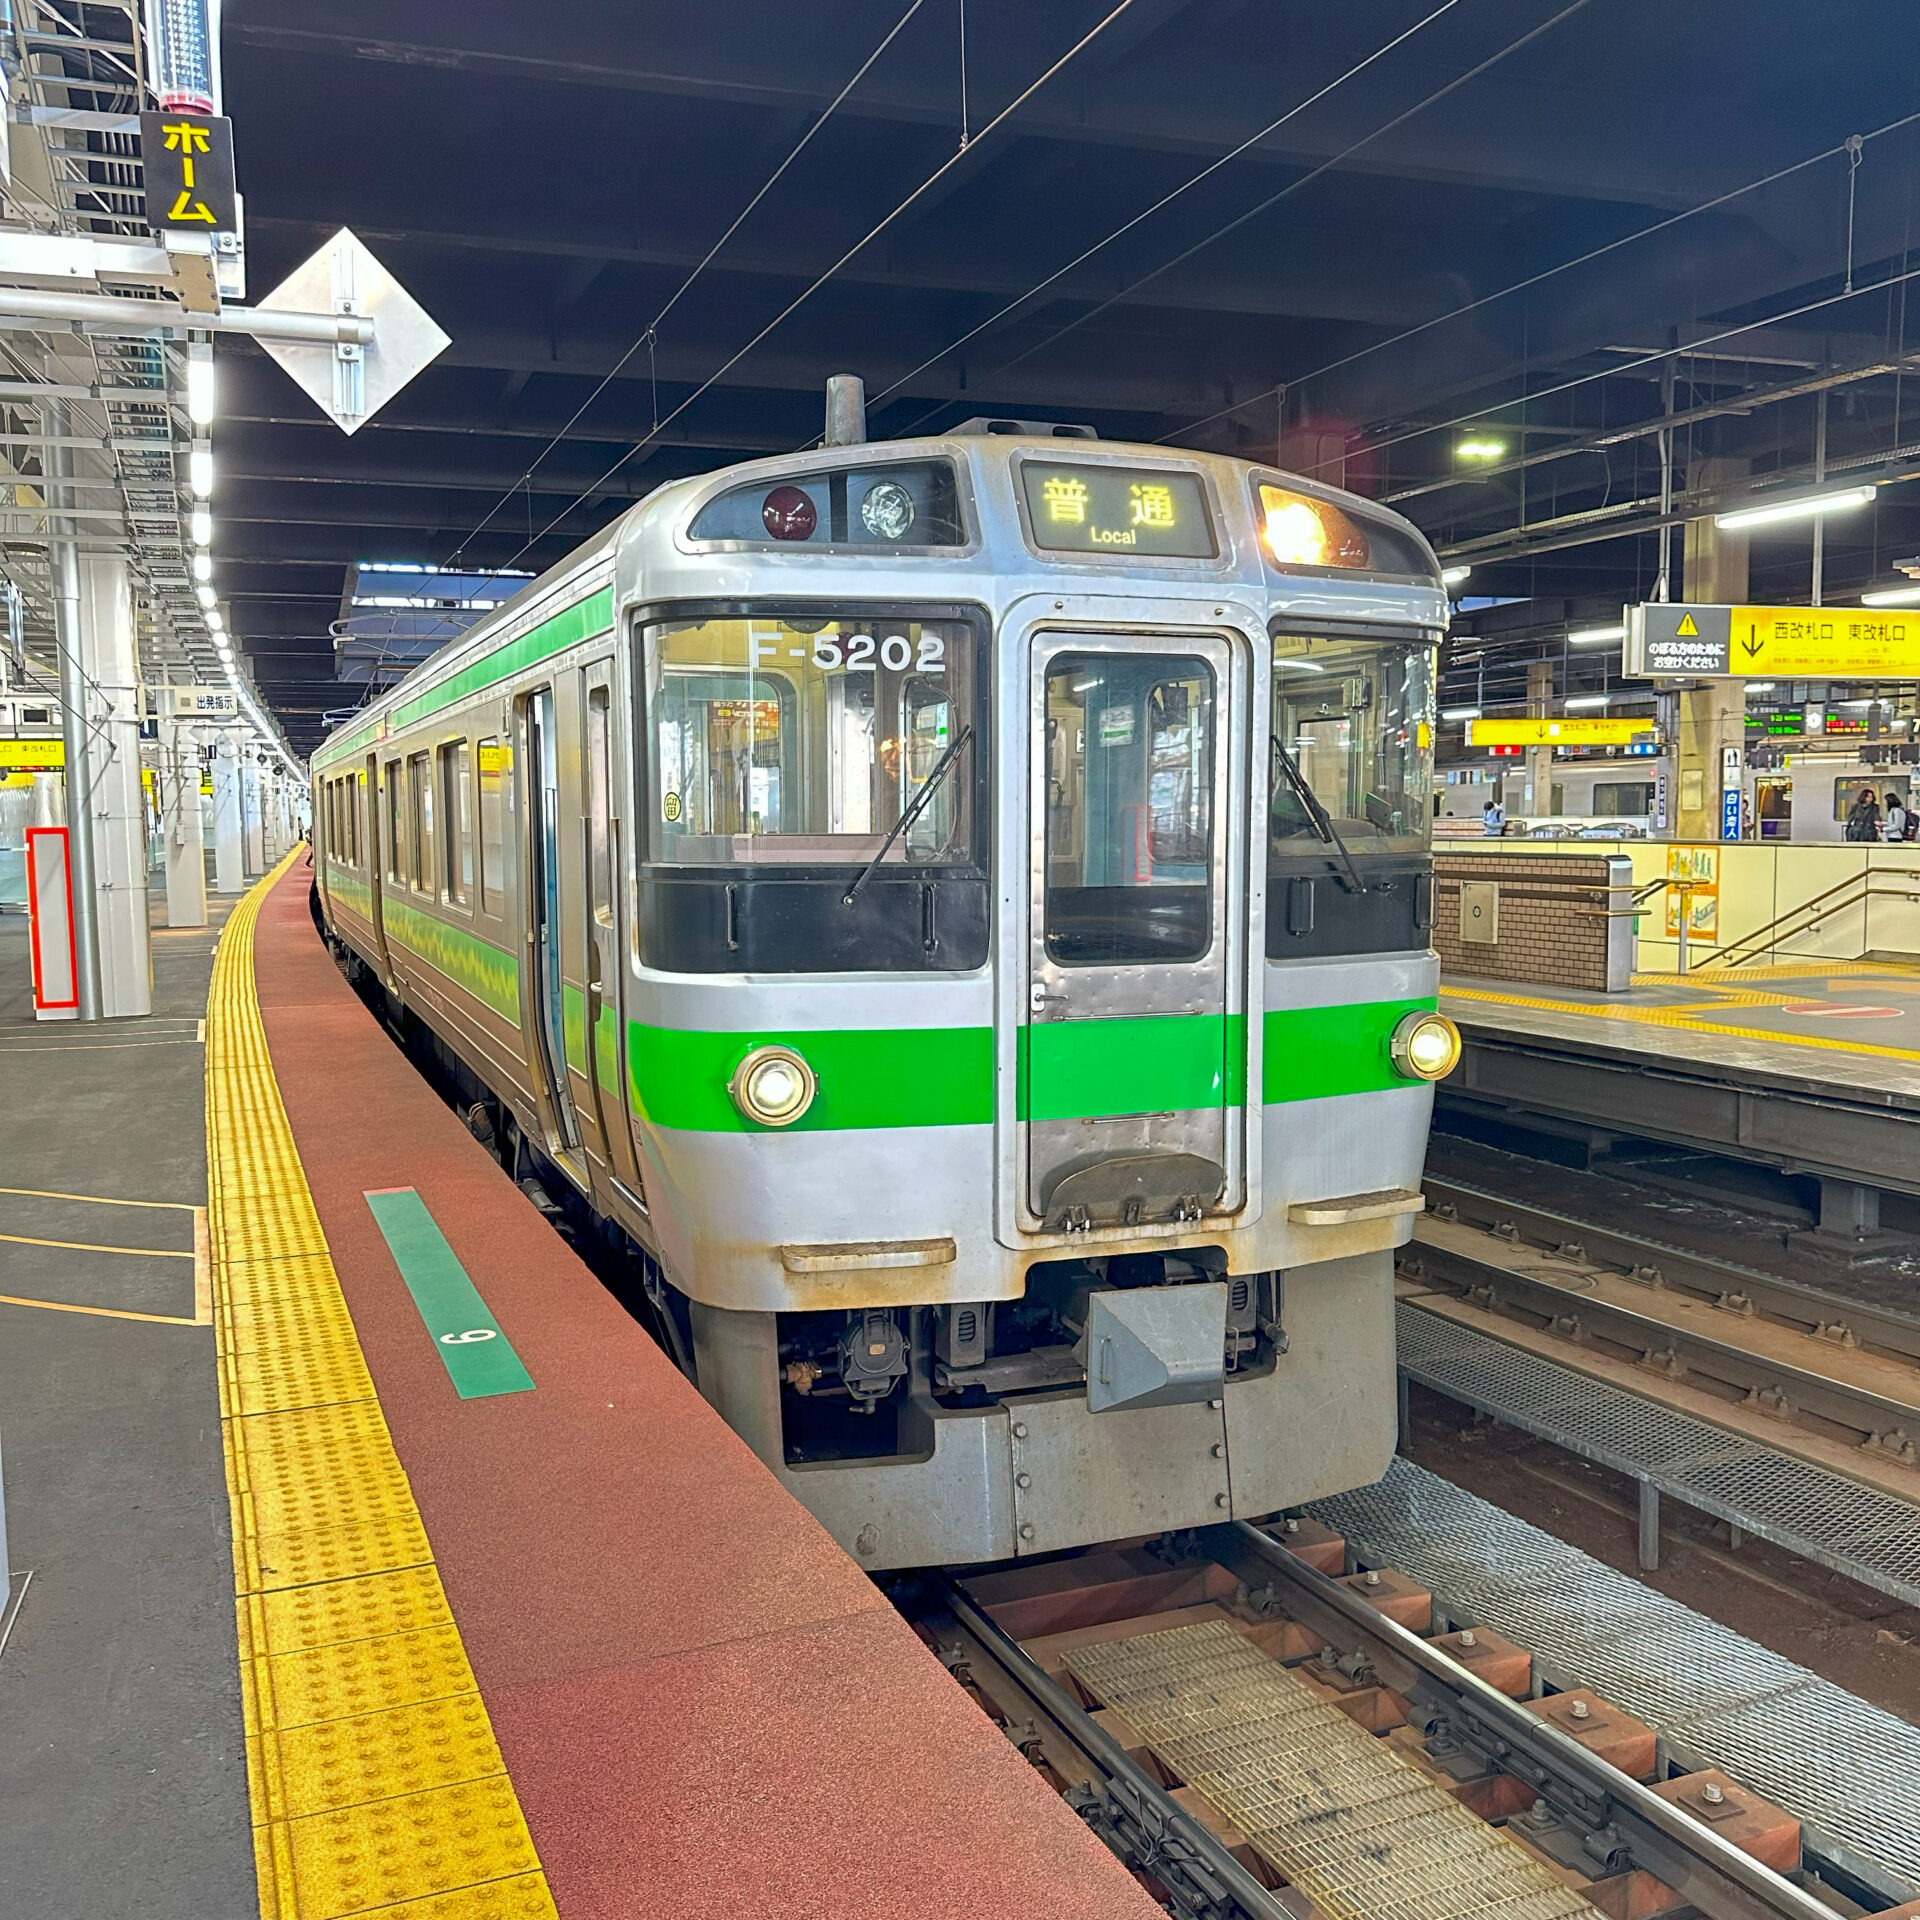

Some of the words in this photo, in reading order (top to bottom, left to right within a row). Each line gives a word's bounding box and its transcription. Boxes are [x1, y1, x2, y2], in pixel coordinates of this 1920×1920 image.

[162, 122, 217, 224] ホーム
[1043, 477, 1175, 527] 普通
[1090, 526, 1137, 545] Local
[1774, 621, 1834, 640] 西改札口
[1848, 623, 1906, 642] 東改札口
[751, 632, 946, 671] F-5202
[1648, 641, 1726, 656] のぼる方のために
[1653, 656, 1720, 669] お空けください
[196, 695, 233, 710] 出発指示
[1726, 792, 1738, 839] 白い恋人
